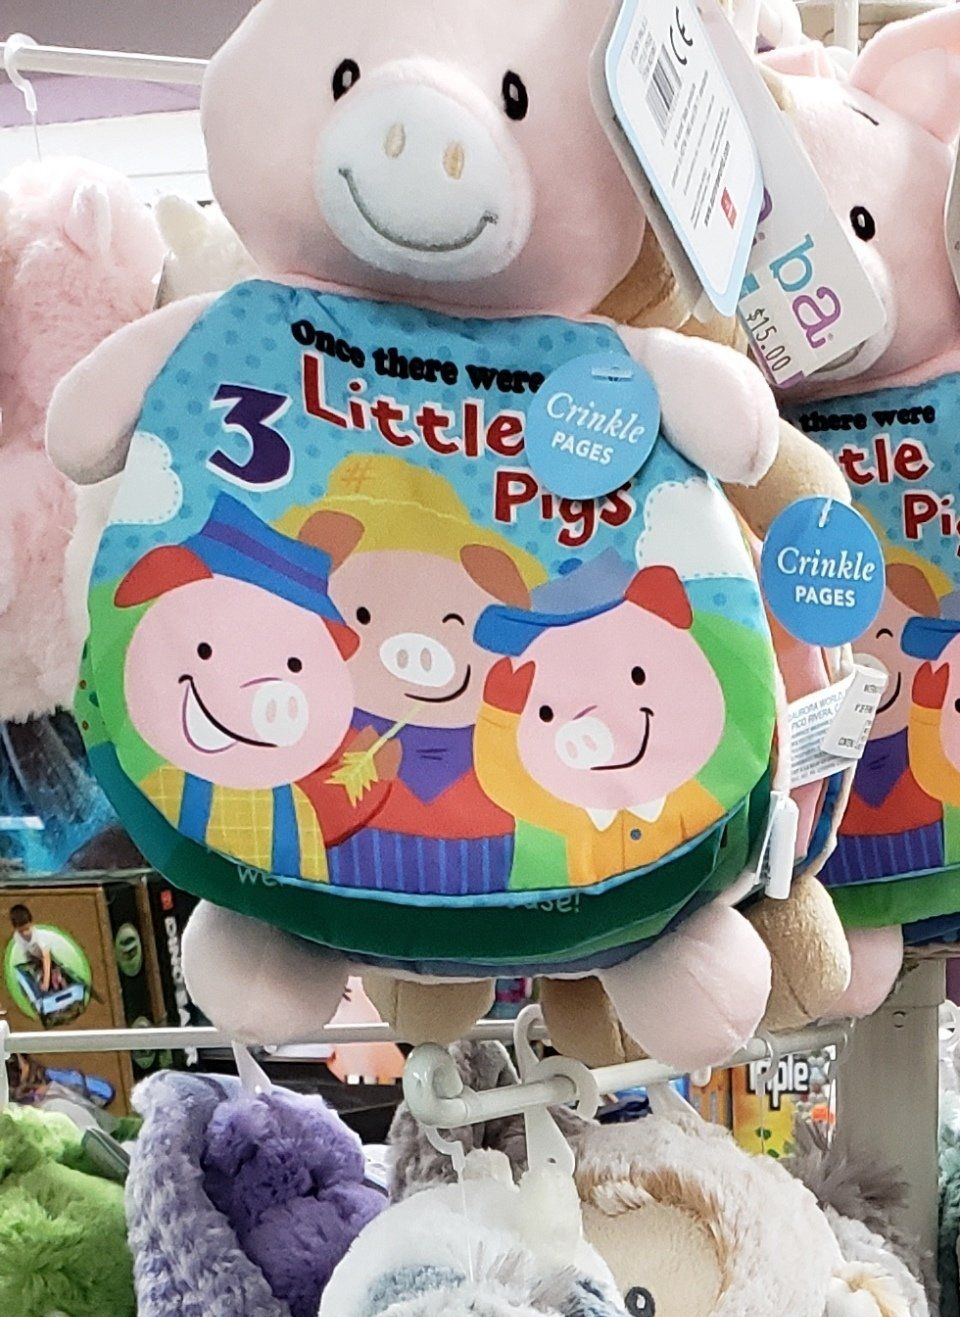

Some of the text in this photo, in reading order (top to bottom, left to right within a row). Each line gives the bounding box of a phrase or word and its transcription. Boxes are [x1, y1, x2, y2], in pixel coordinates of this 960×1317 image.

[291, 319, 544, 394] Once there were
[746, 308, 791, 371] $15.00
[207, 353, 525, 485] 3 Little
[546, 391, 646, 445] Crinkle
[801, 404, 935, 432] there were
[551, 430, 614, 466] PAGES
[839, 438, 929, 485] tle
[495, 470, 633, 547] Pigs
[777, 546, 876, 582] Crinkle
[795, 585, 855, 607] PAGES
